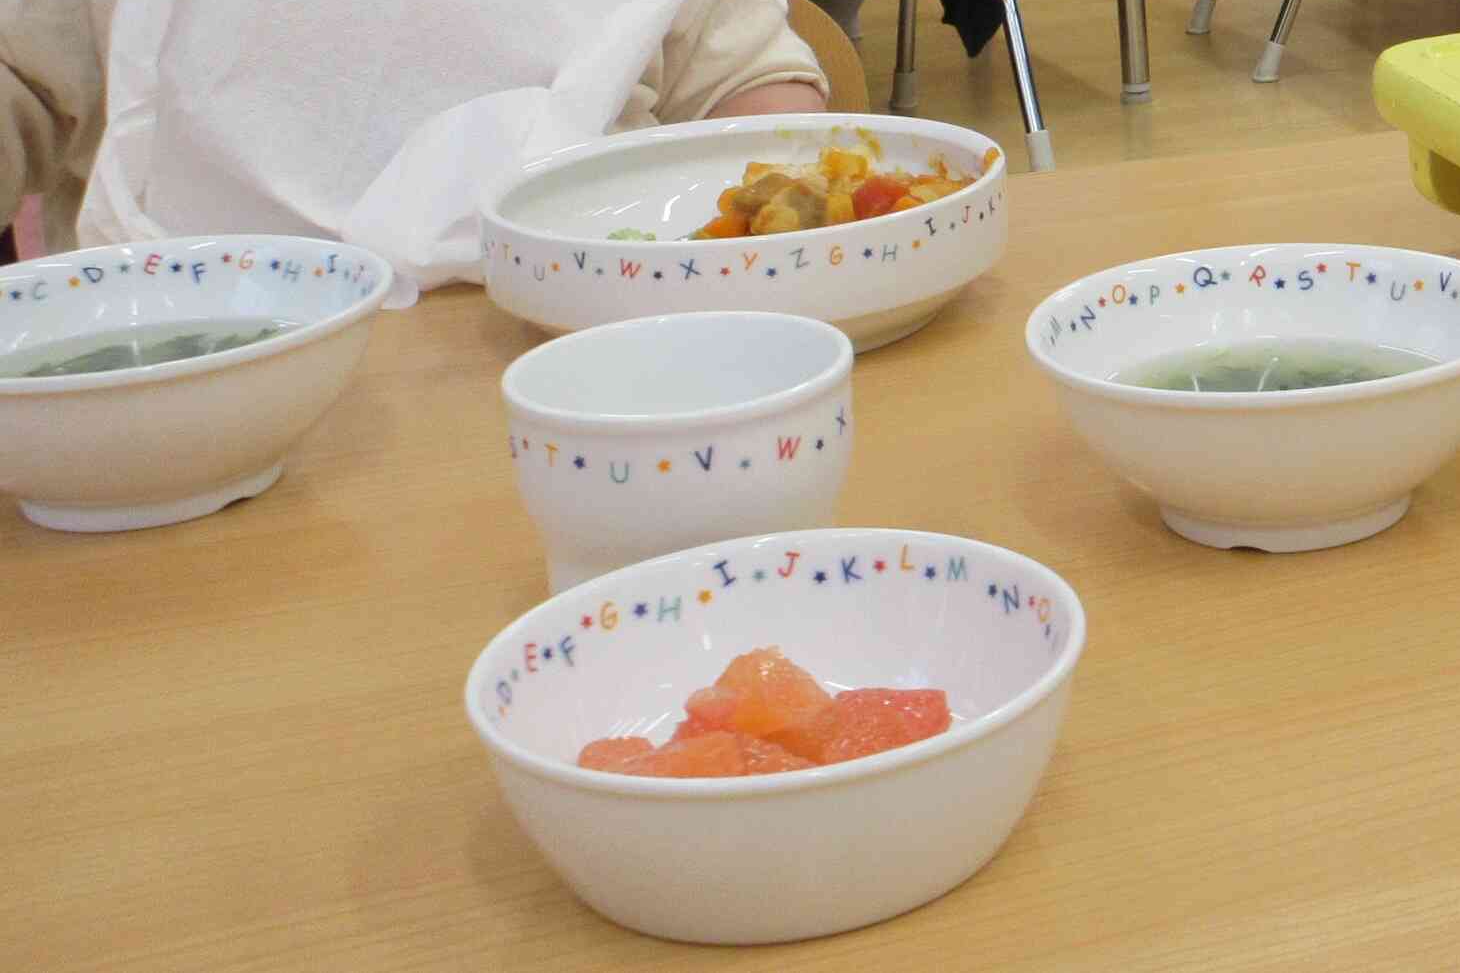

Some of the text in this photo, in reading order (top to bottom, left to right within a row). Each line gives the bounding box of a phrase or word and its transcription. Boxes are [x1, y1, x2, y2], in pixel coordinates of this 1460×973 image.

[31, 280, 48, 300] C
[81, 267, 104, 284] D
[143, 253, 163, 275] E
[189, 261, 208, 284] F
[239, 250, 255, 270] G
[327, 253, 338, 274] I
[533, 264, 546, 282] U
[573, 251, 586, 270] V
[620, 258, 642, 279] W
[680, 258, 702, 281] X
[742, 252, 760, 272] Y
[829, 245, 845, 267] G
[881, 244, 898, 263] H
[924, 216, 937, 236] I
[961, 205, 971, 224] J
[1080, 304, 1097, 331] N
[1112, 284, 1126, 305] O
[1149, 284, 1161, 306] P
[1192, 265, 1219, 291] Q
[1247, 265, 1268, 287] R
[1296, 269, 1314, 291] S
[1344, 259, 1362, 283] T
[1390, 282, 1407, 302] U
[1439, 271, 1453, 292] V
[544, 442, 559, 468] T
[609, 462, 630, 484] U
[694, 444, 716, 472] V
[776, 436, 801, 461] W
[523, 641, 539, 673] E
[558, 635, 576, 667] F
[598, 601, 621, 633] G
[656, 596, 682, 623] H
[712, 558, 737, 590] I
[776, 550, 801, 580] J
[840, 554, 864, 584] K
[899, 544, 916, 573] L
[946, 556, 969, 581] M
[1001, 584, 1020, 615] N
